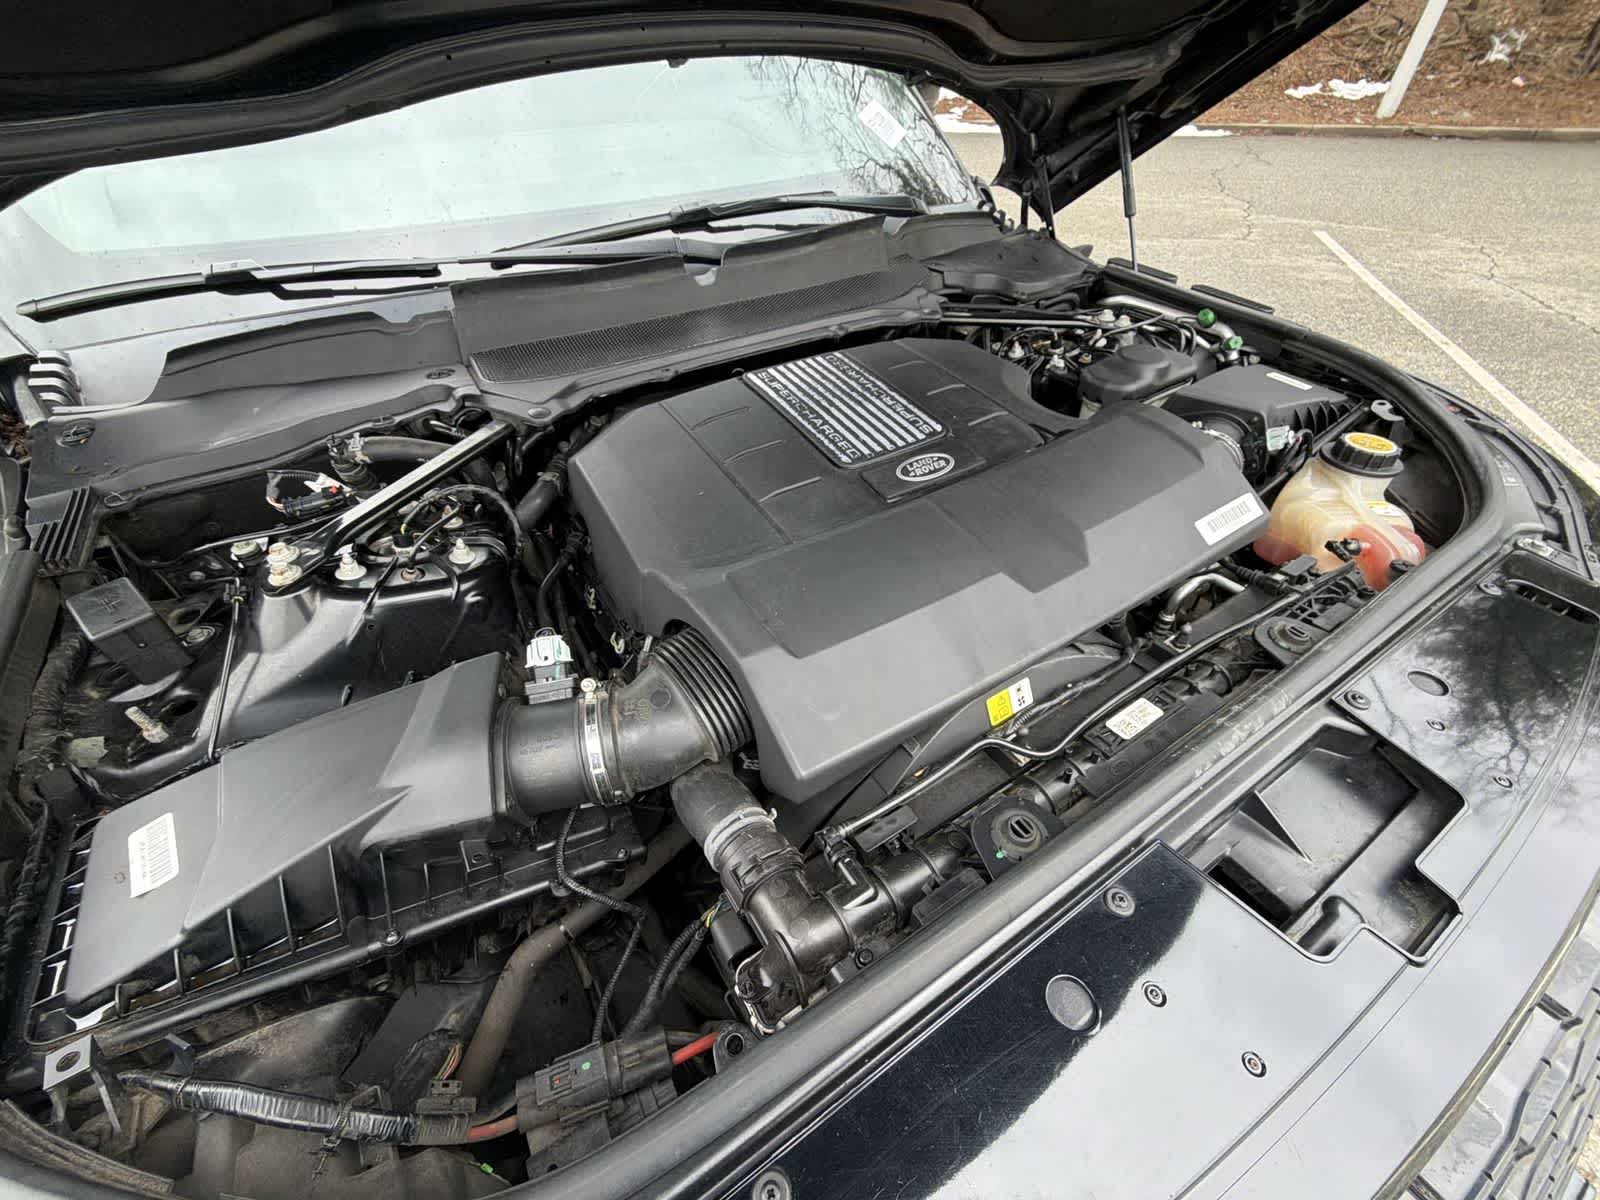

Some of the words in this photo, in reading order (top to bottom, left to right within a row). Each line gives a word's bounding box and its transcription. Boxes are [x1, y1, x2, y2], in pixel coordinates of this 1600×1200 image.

[757, 371, 862, 459] SUPERCHARGED
[906, 457, 933, 471] LAND
[914, 459, 947, 476] ROVER
